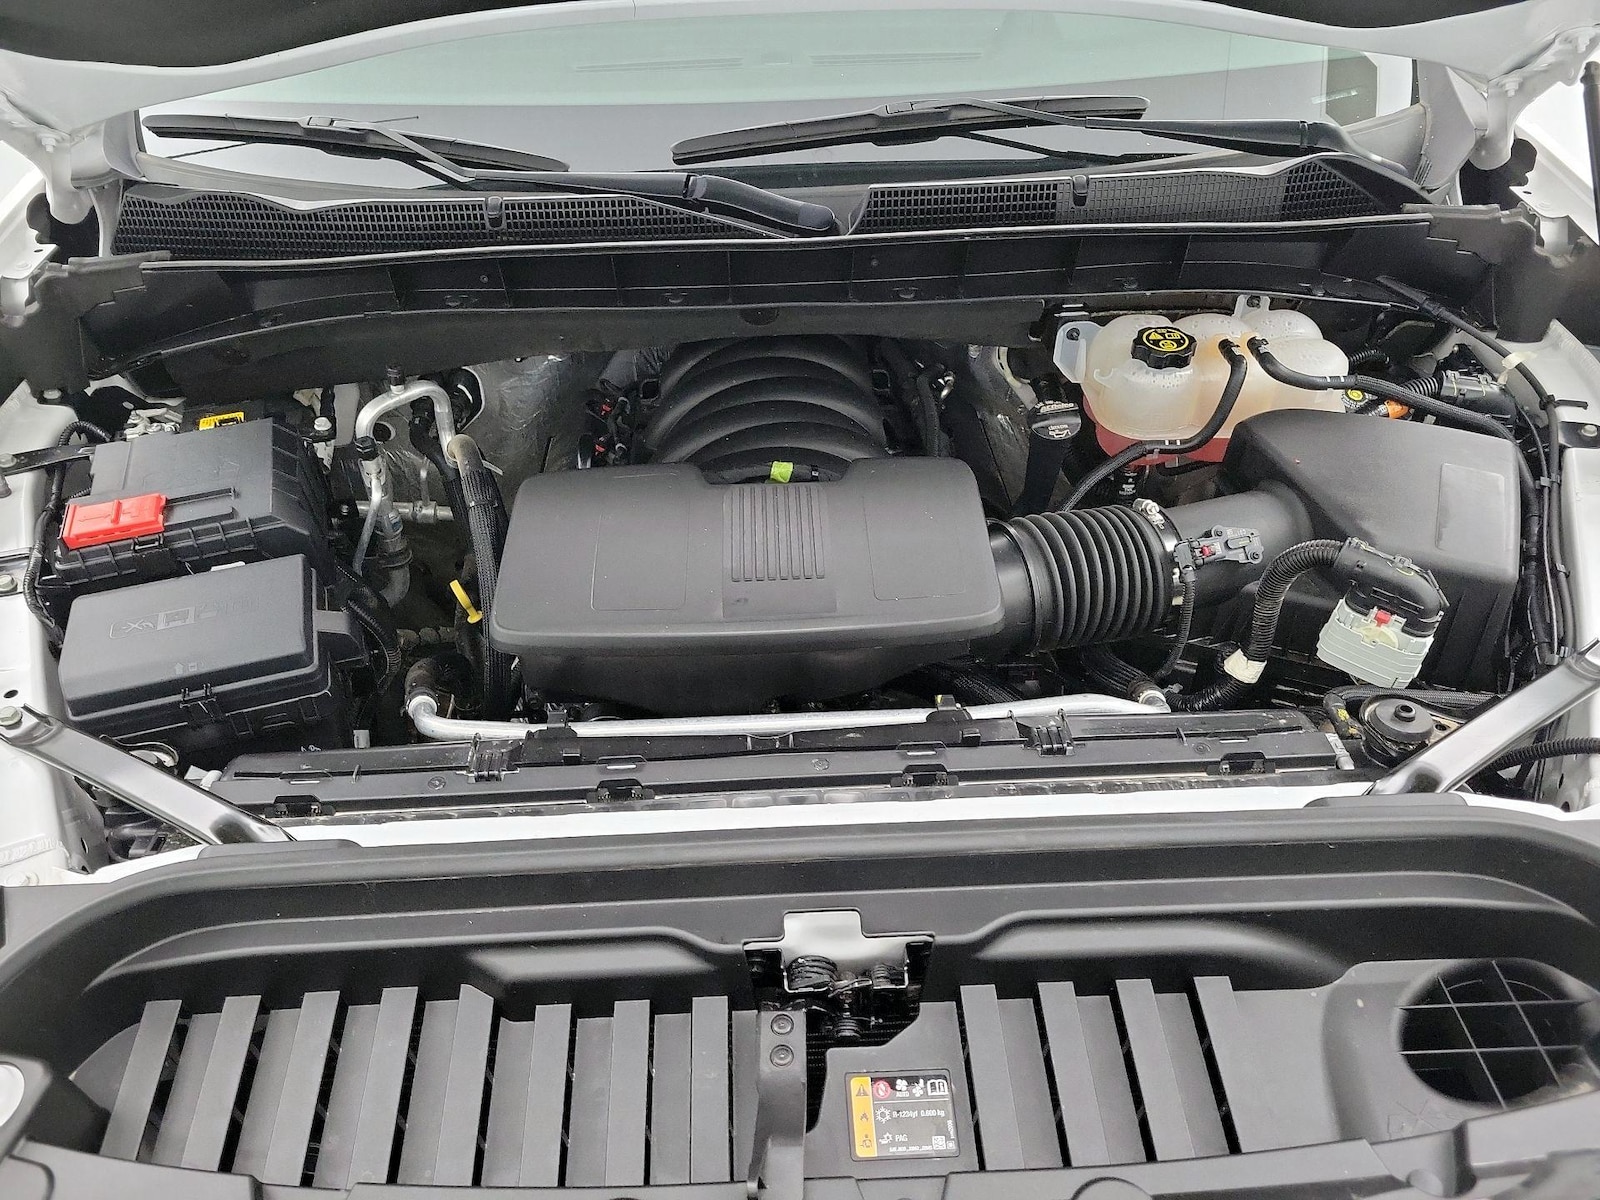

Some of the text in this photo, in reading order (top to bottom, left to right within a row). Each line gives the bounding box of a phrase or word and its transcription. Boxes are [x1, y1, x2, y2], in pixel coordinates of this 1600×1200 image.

[1040, 403, 1074, 413] ACDelco
[937, 1109, 945, 1118] kg
[895, 1134, 908, 1142] PAG
